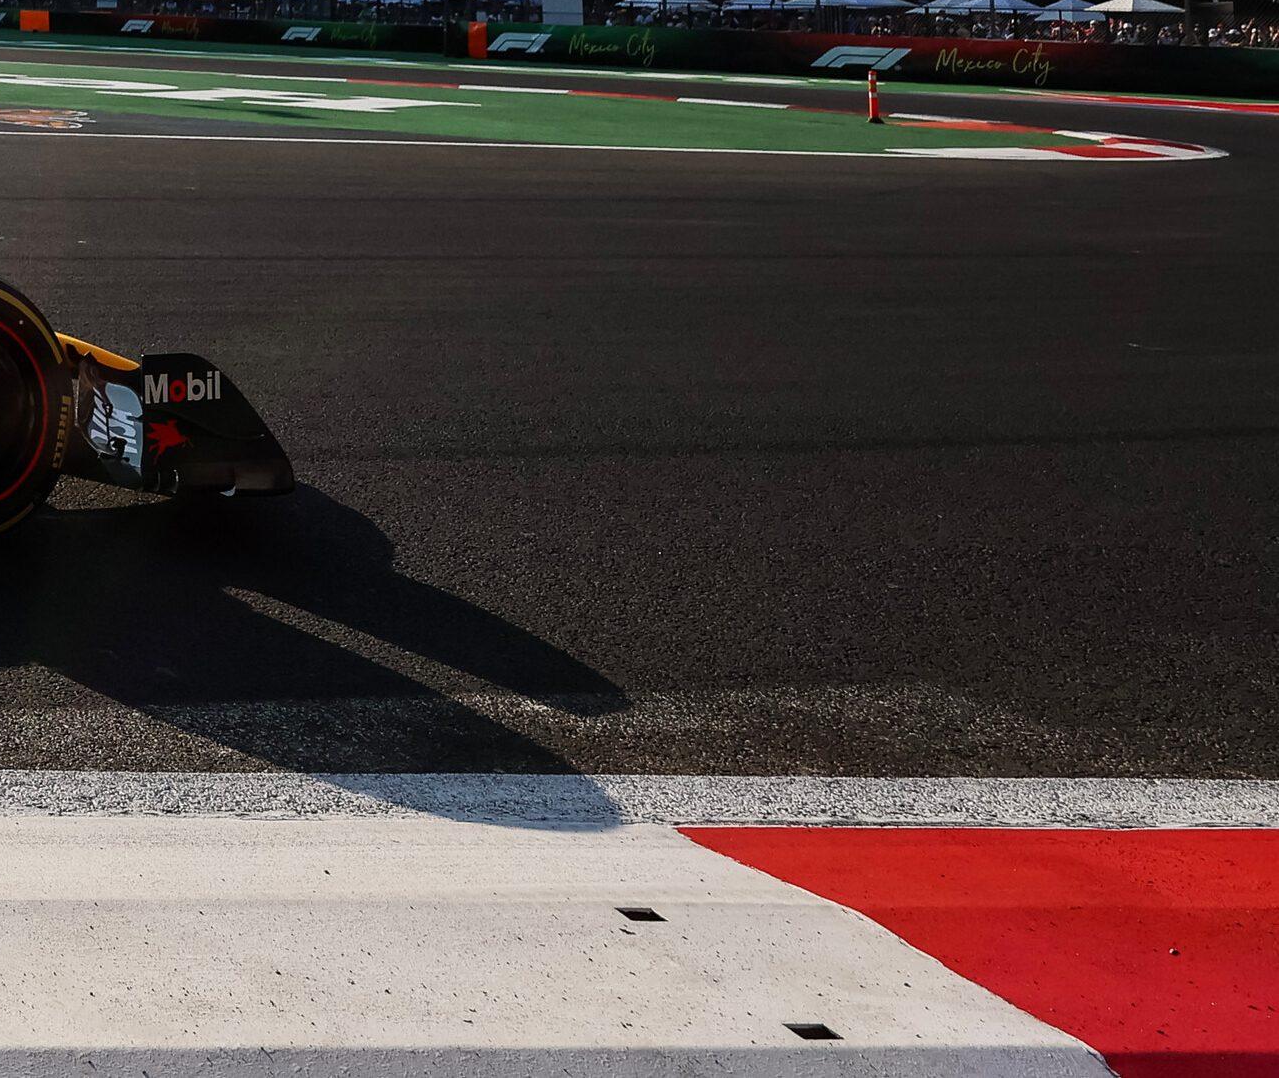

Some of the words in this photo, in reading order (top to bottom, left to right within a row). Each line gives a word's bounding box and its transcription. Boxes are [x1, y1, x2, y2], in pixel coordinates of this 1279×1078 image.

[120, 19, 154, 33] F1
[280, 26, 323, 43] F1
[486, 32, 553, 54] F1
[568, 32, 621, 57] Mexico
[809, 45, 913, 70] F1
[934, 46, 1006, 75] Mexico
[1012, 42, 1057, 87] City
[144, 370, 222, 405] Mobil
